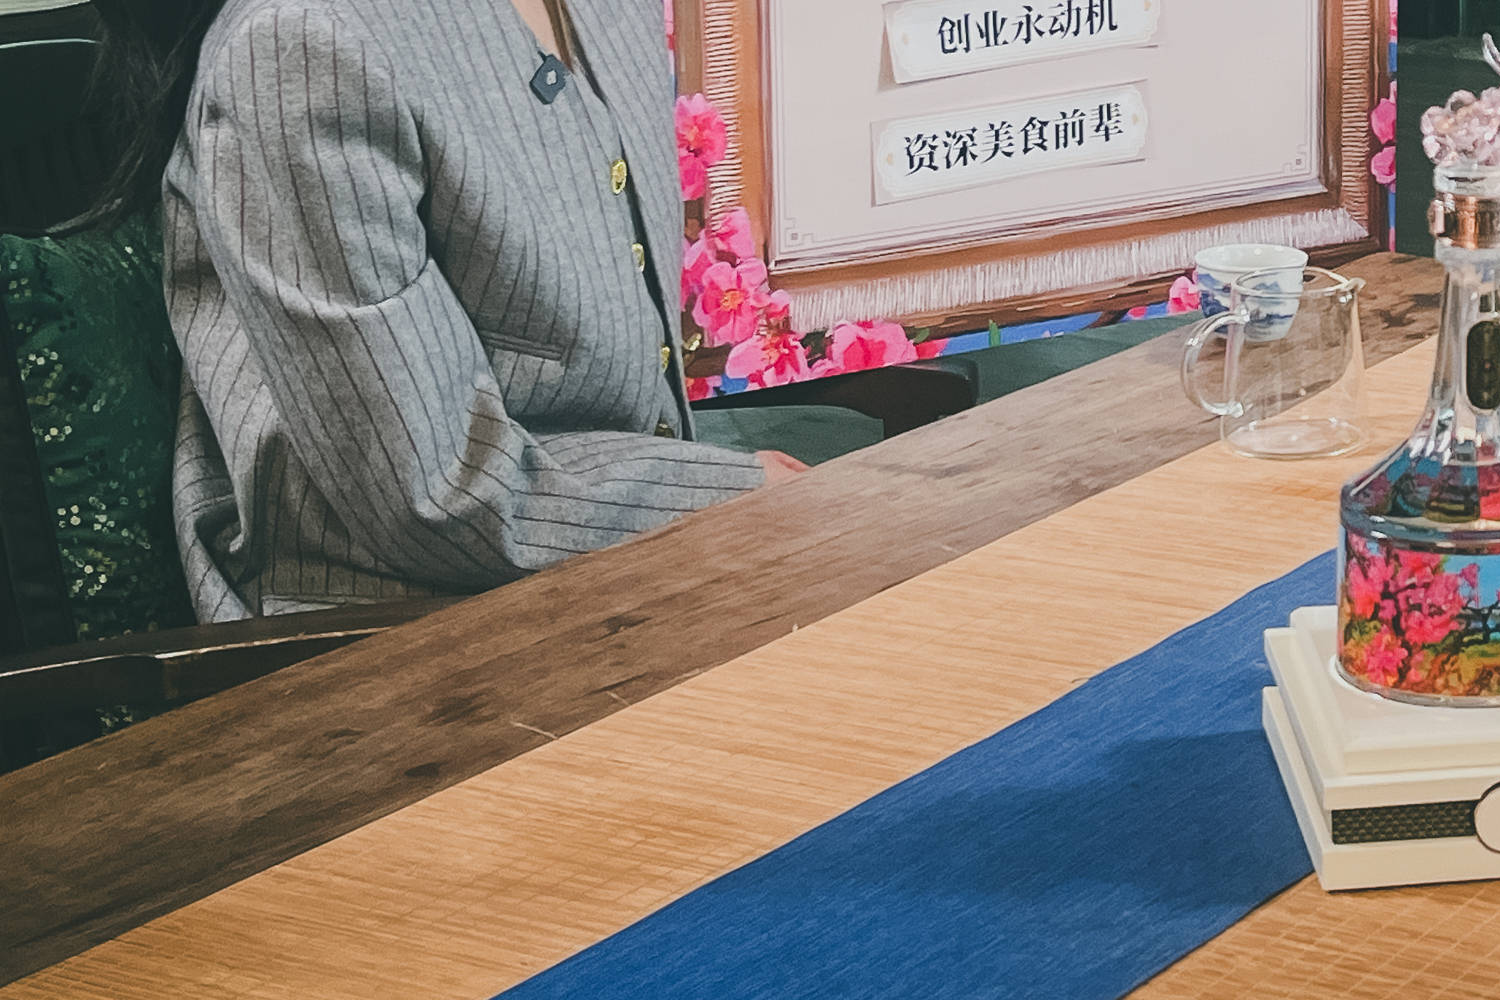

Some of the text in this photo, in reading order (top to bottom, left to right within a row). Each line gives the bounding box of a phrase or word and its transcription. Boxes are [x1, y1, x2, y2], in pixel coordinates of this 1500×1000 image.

[904, 102, 1124, 177] 资深美食前辈
